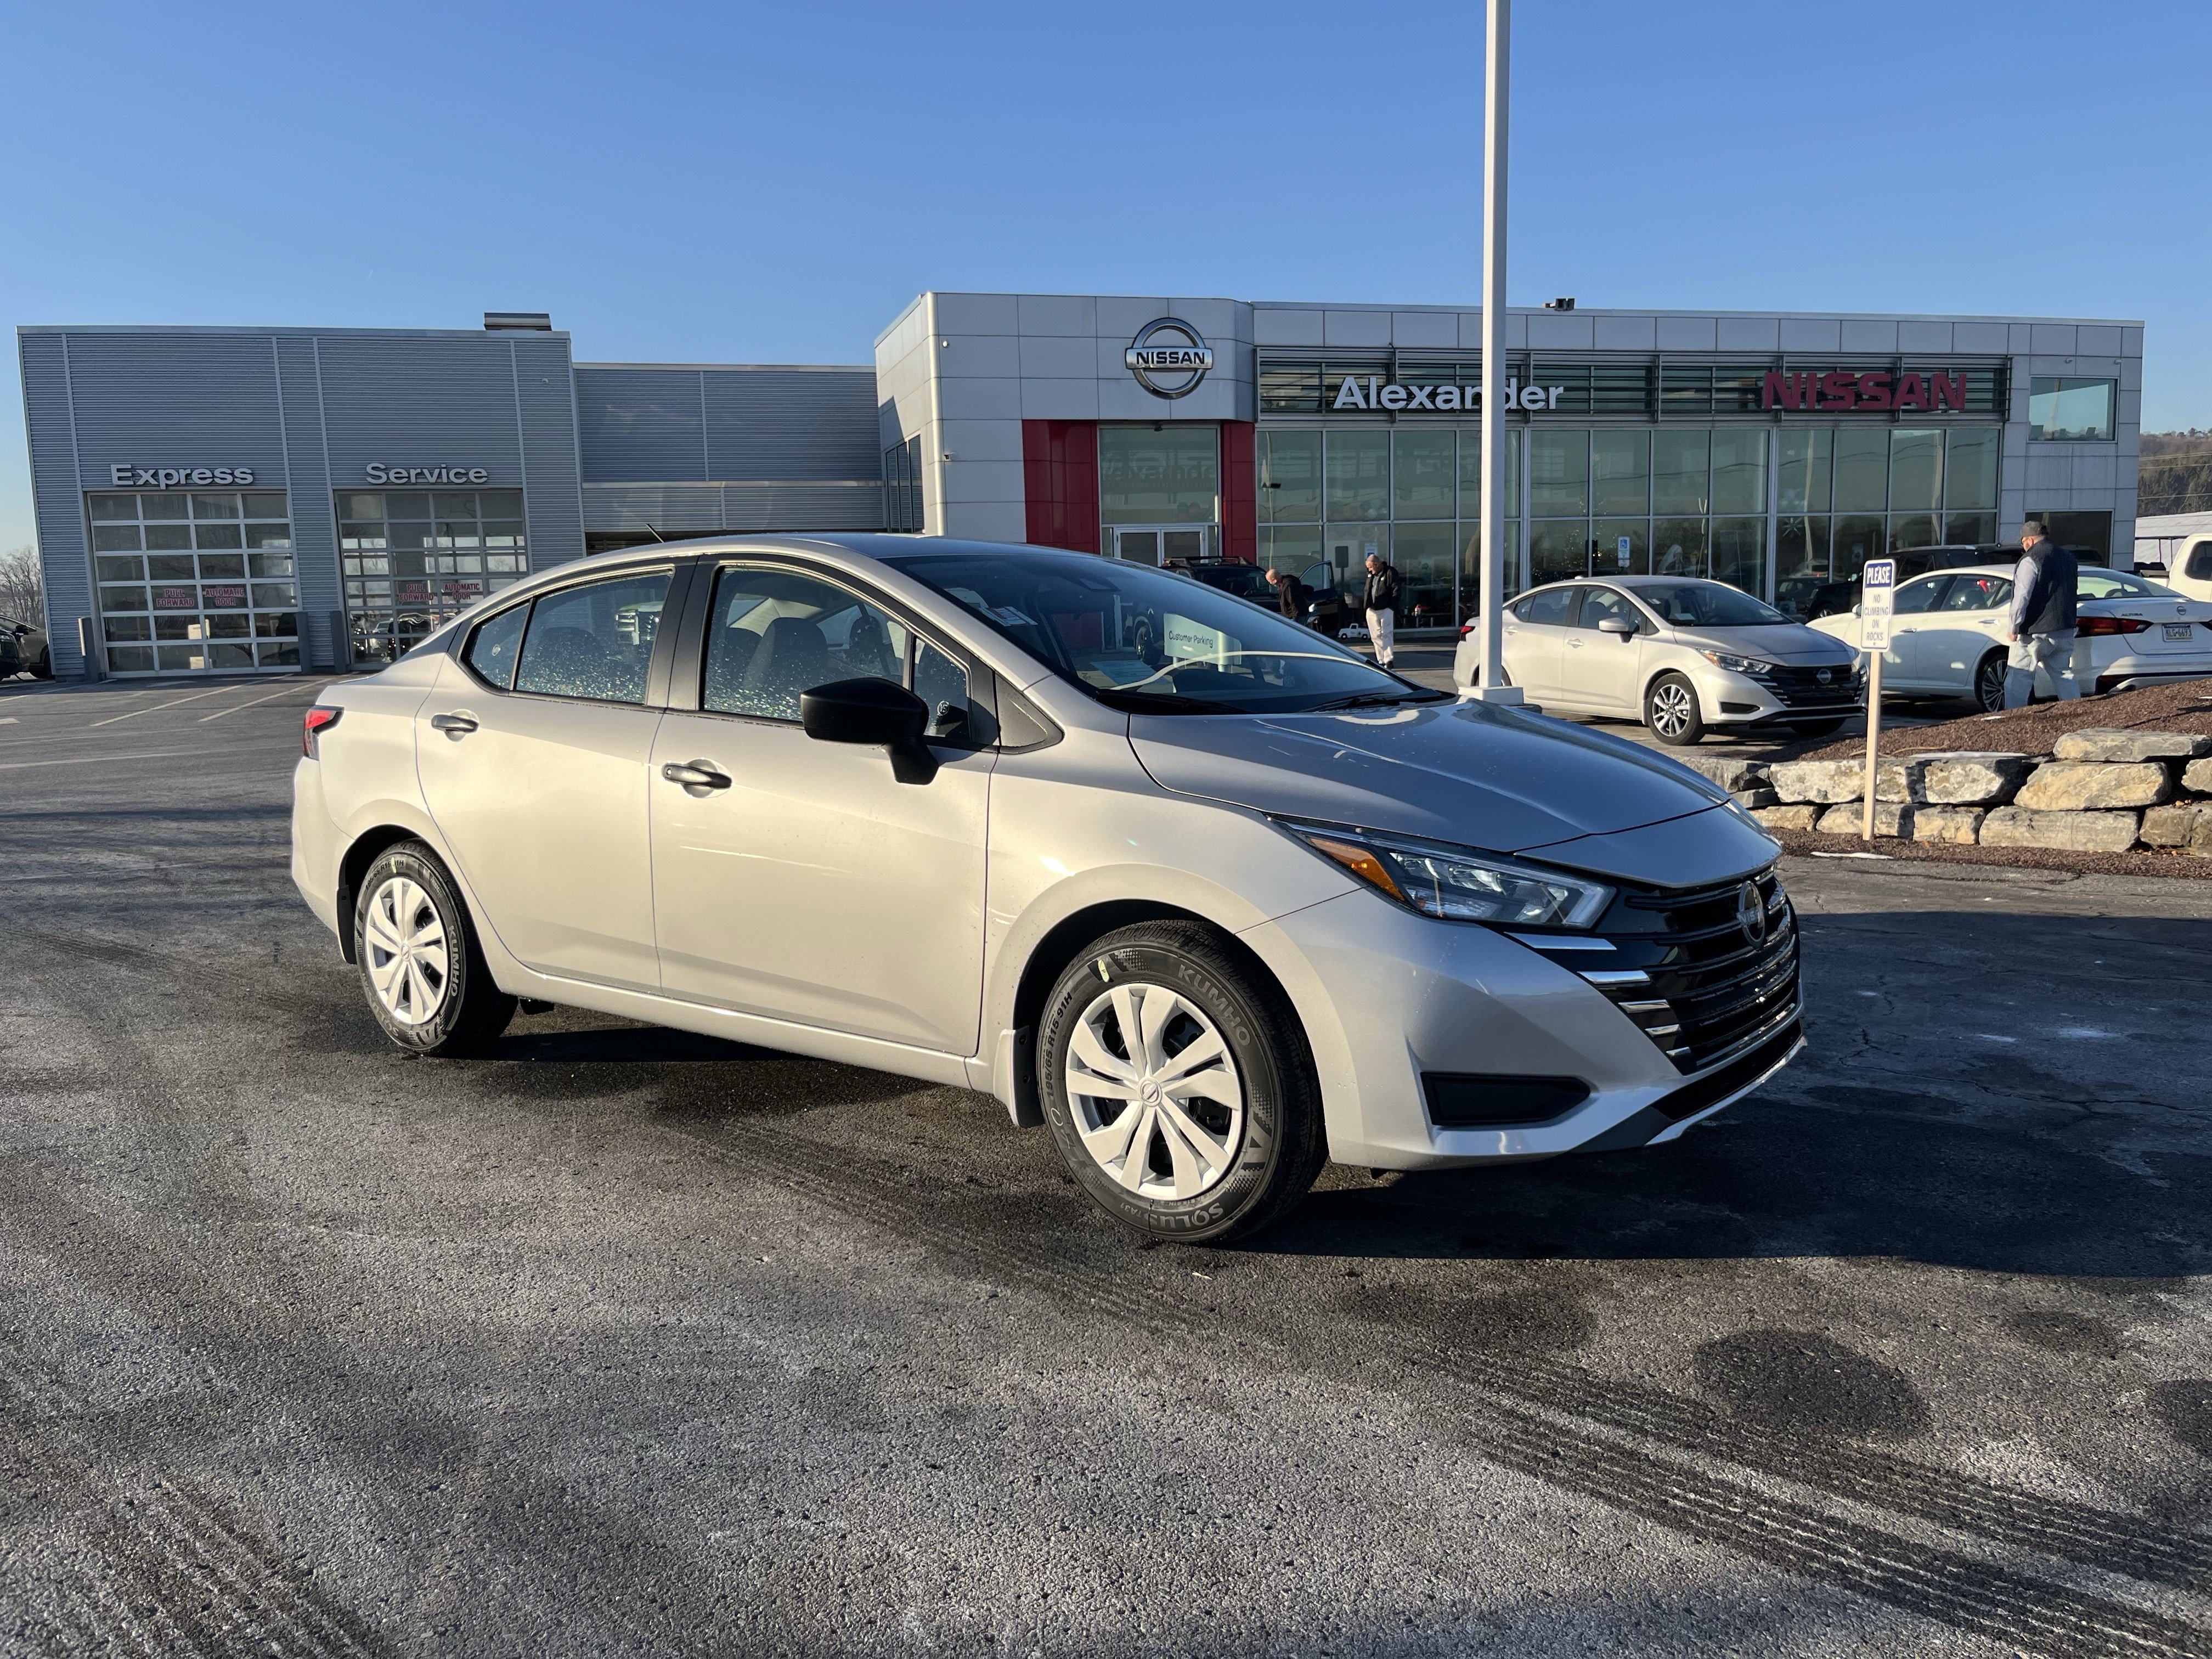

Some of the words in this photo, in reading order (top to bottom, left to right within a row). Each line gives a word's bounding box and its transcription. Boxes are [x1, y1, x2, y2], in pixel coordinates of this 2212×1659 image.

[1136, 351, 1205, 364] NISSAN
[1333, 376, 1564, 410] Alexander
[1762, 372, 1967, 411] NISSAN
[110, 464, 253, 490] Express
[365, 462, 488, 484] Service
[1866, 567, 1891, 584] PLEASE
[165, 589, 185, 597] PULL
[205, 588, 245, 597] AUTOMATIC
[407, 584, 425, 593] PULL
[444, 583, 480, 591] AUTOMATIC
[215, 597, 236, 606] DOOR
[399, 592, 435, 602] FORWARD
[453, 591, 471, 600] DOOR
[1873, 594, 1881, 603] NO
[156, 598, 195, 607] FORWARD
[1865, 606, 1889, 616] CLIMBING
[1872, 619, 1880, 629] ON
[1169, 630, 1193, 643] Customer
[1193, 635, 1214, 648] Parking
[1866, 631, 1883, 641] ROCKS
[448, 925, 460, 997] KUMHO
[1056, 991, 1073, 1019] 91H
[1178, 964, 1251, 1046] KUMHO
[1047, 1018, 1059, 1048] R15
[1045, 1050, 1054, 1099] 195/65
[1143, 1202, 1223, 1229] SOLUS
